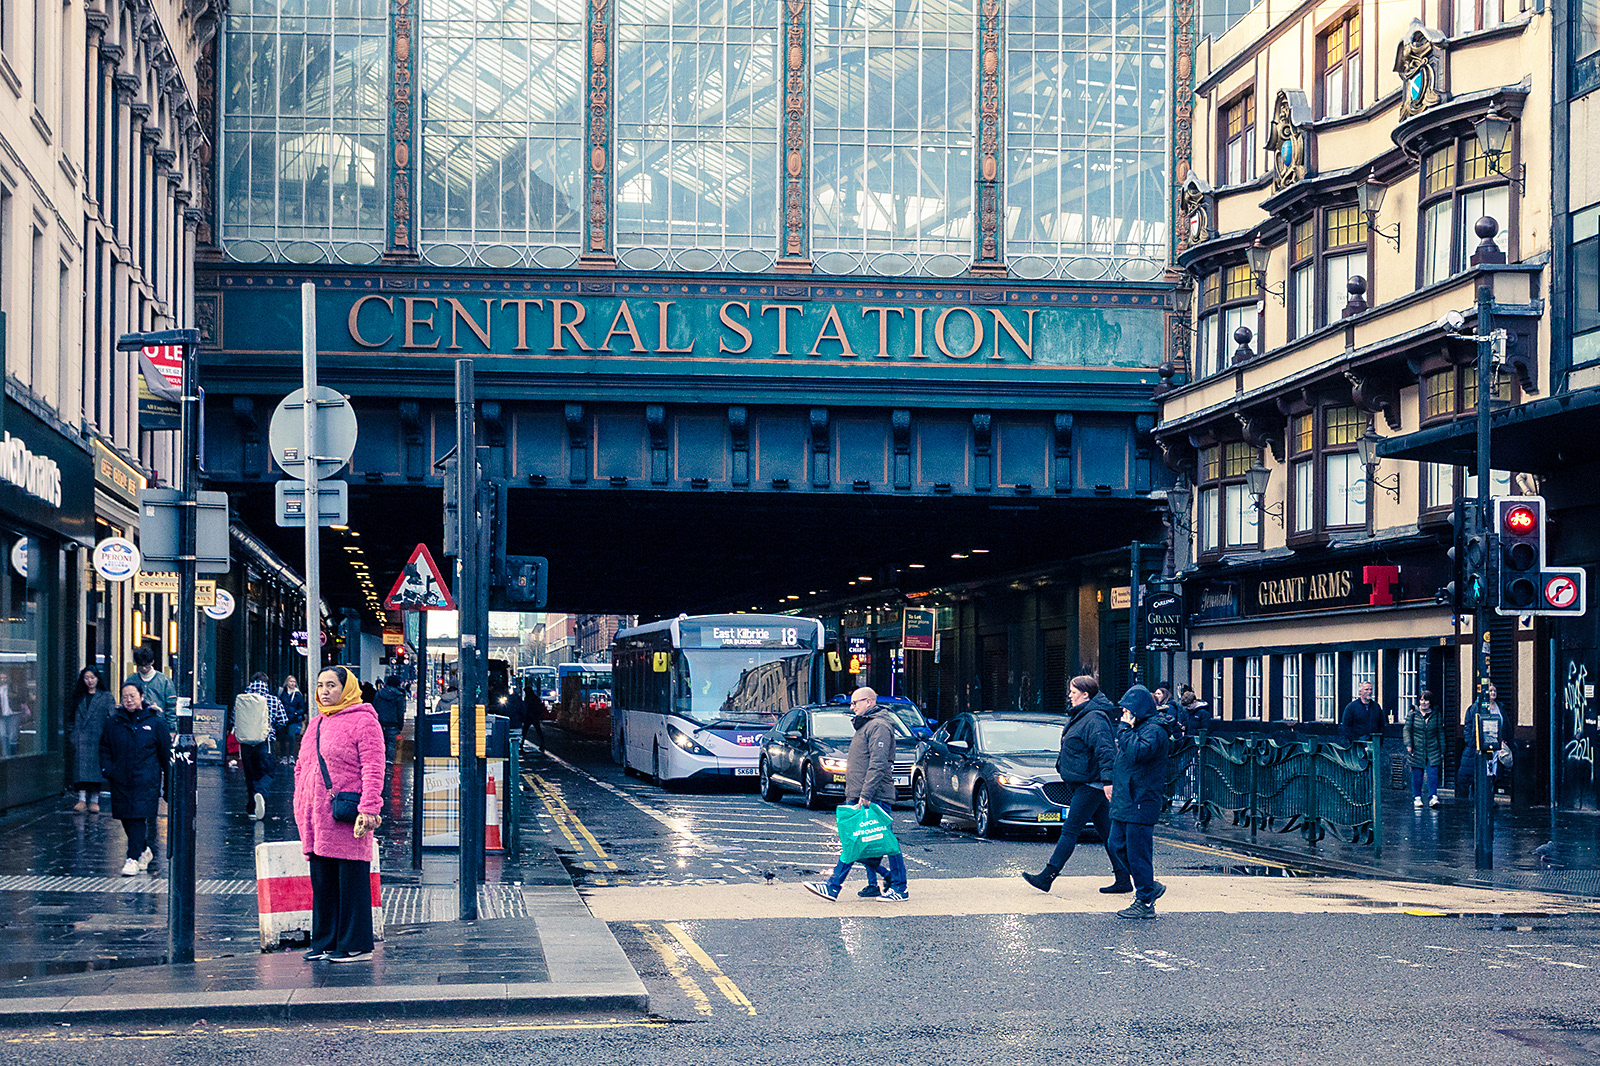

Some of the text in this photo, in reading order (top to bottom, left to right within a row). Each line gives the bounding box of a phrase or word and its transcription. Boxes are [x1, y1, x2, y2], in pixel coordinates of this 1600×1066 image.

[348, 294, 1035, 360] CENTRAL STATION
[102, 552, 132, 562] PERONI
[1258, 570, 1351, 606] GRANT ARMS
[1152, 598, 1175, 608] CARLING
[1147, 612, 1181, 624] GRANT
[1153, 626, 1177, 635] ARMS
[714, 628, 797, 646] East Kilbride 18
[736, 734, 754, 743] First
[424, 776, 442, 791] Bin
